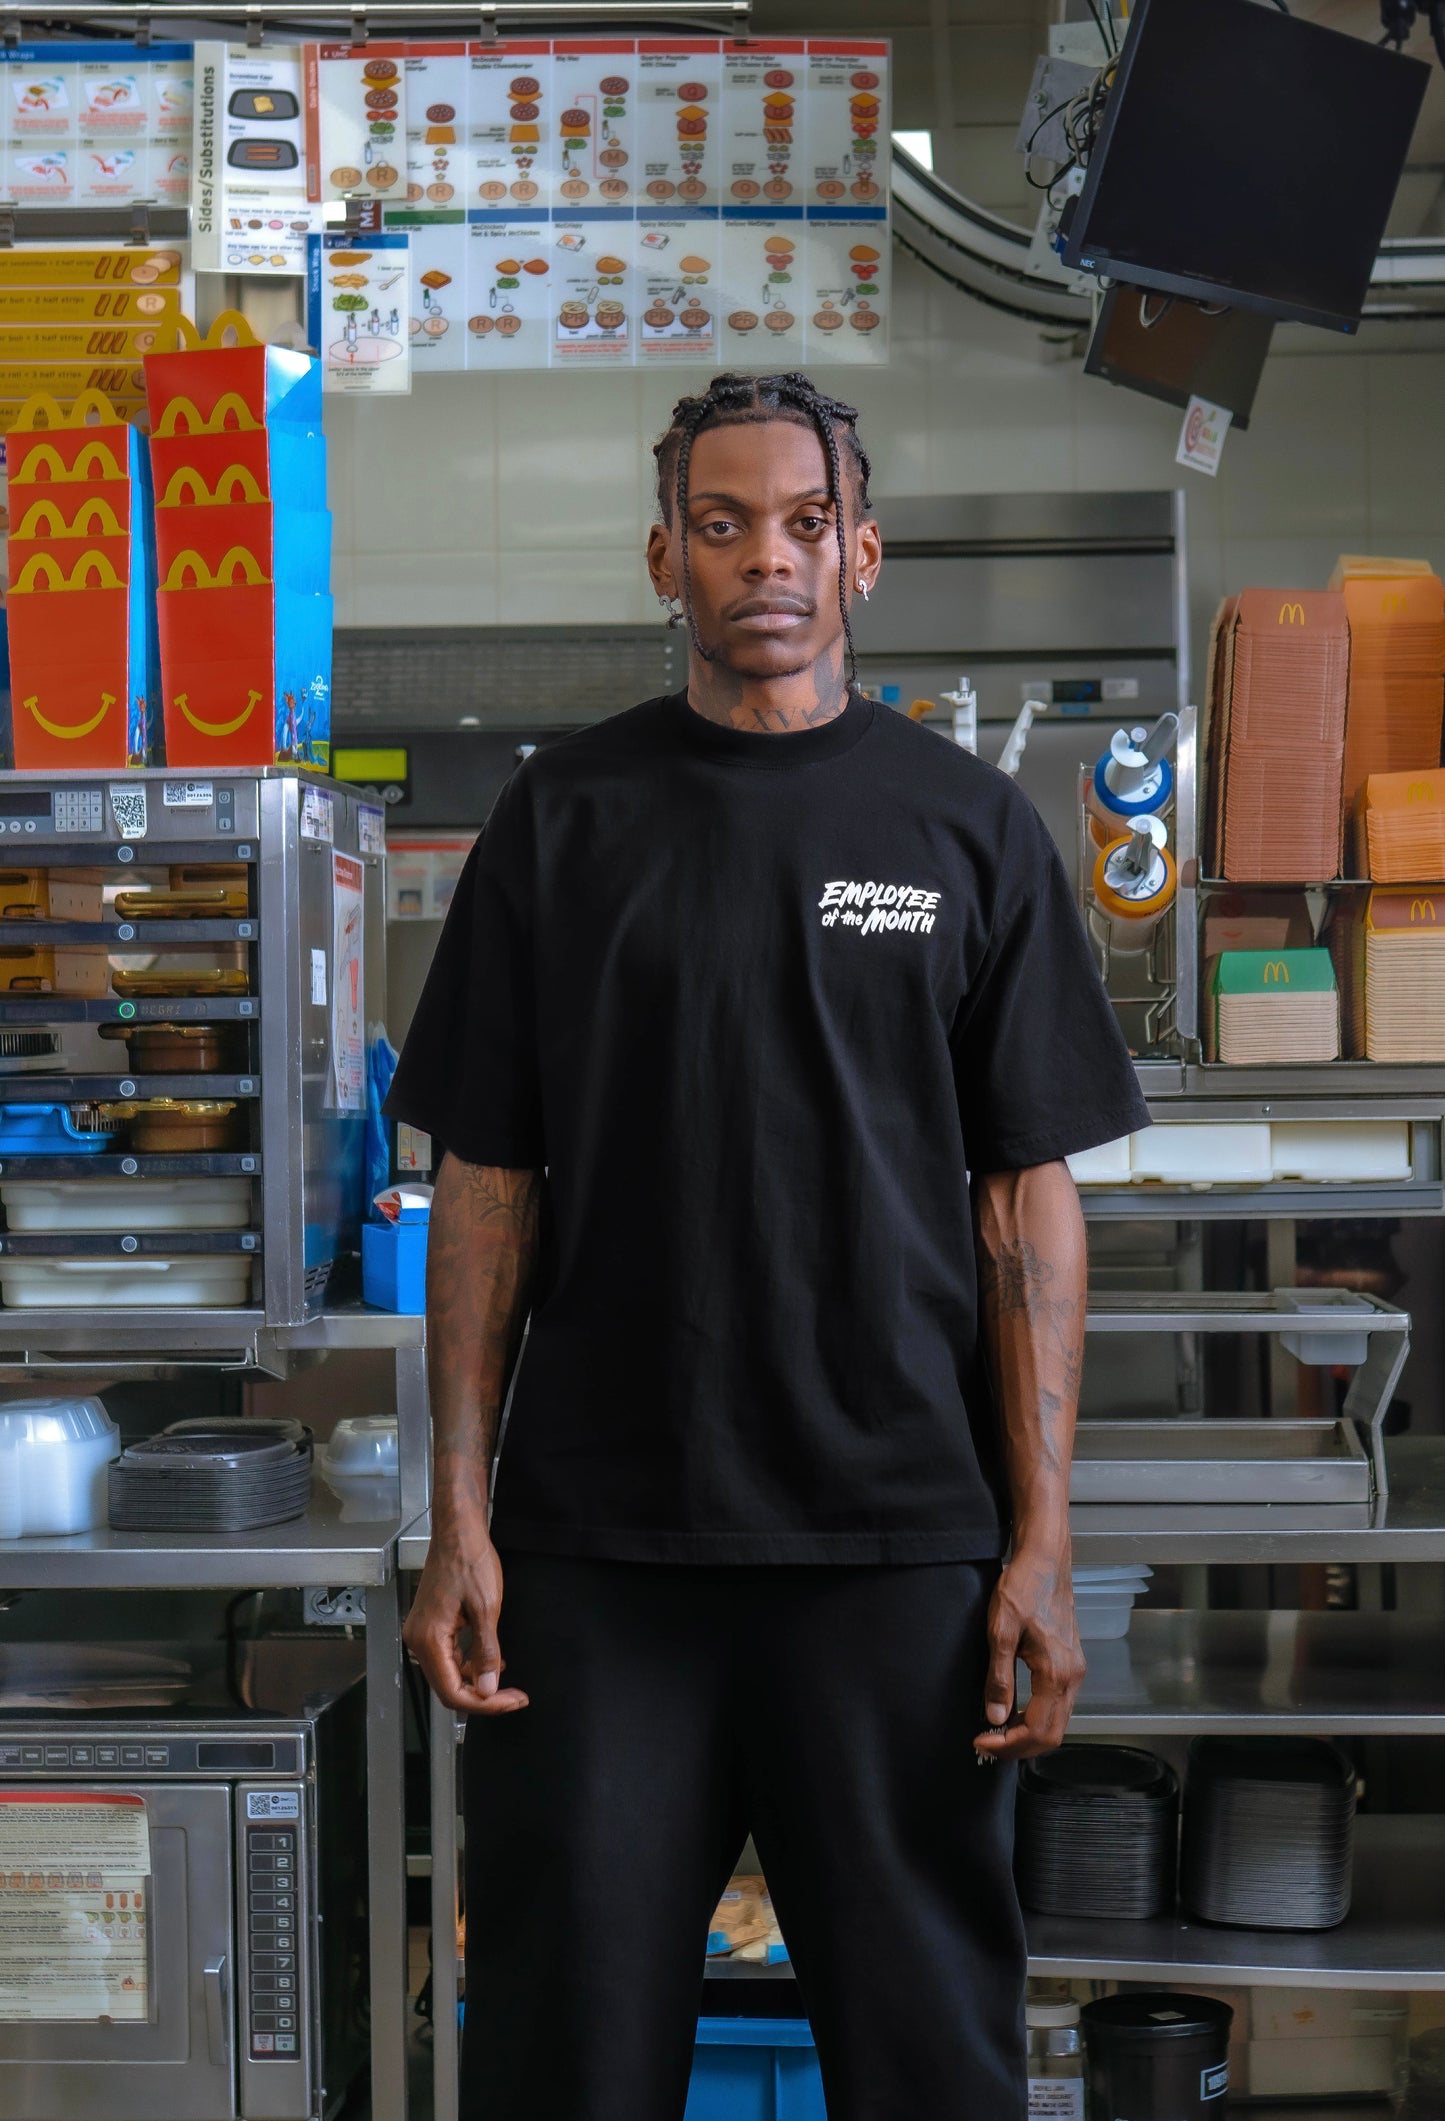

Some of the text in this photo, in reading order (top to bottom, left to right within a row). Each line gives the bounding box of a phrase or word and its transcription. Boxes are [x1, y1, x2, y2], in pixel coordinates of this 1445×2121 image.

[198, 66, 215, 233] Sides/Substitutions
[1080, 259, 1096, 268] NEC
[818, 881, 942, 910] EMPLOYEE
[822, 907, 936, 937] of the MONTH
[279, 1837, 287, 1847] 1
[277, 1858, 289, 1868] 2
[277, 1878, 289, 1887] 3
[277, 1897, 289, 1907] 4
[278, 1917, 289, 1928] 5
[278, 1937, 290, 1947] 6
[278, 1958, 290, 1968] 7
[278, 1977, 290, 1987] 8
[279, 1997, 291, 2007] 9
[279, 2017, 291, 2027] 0
